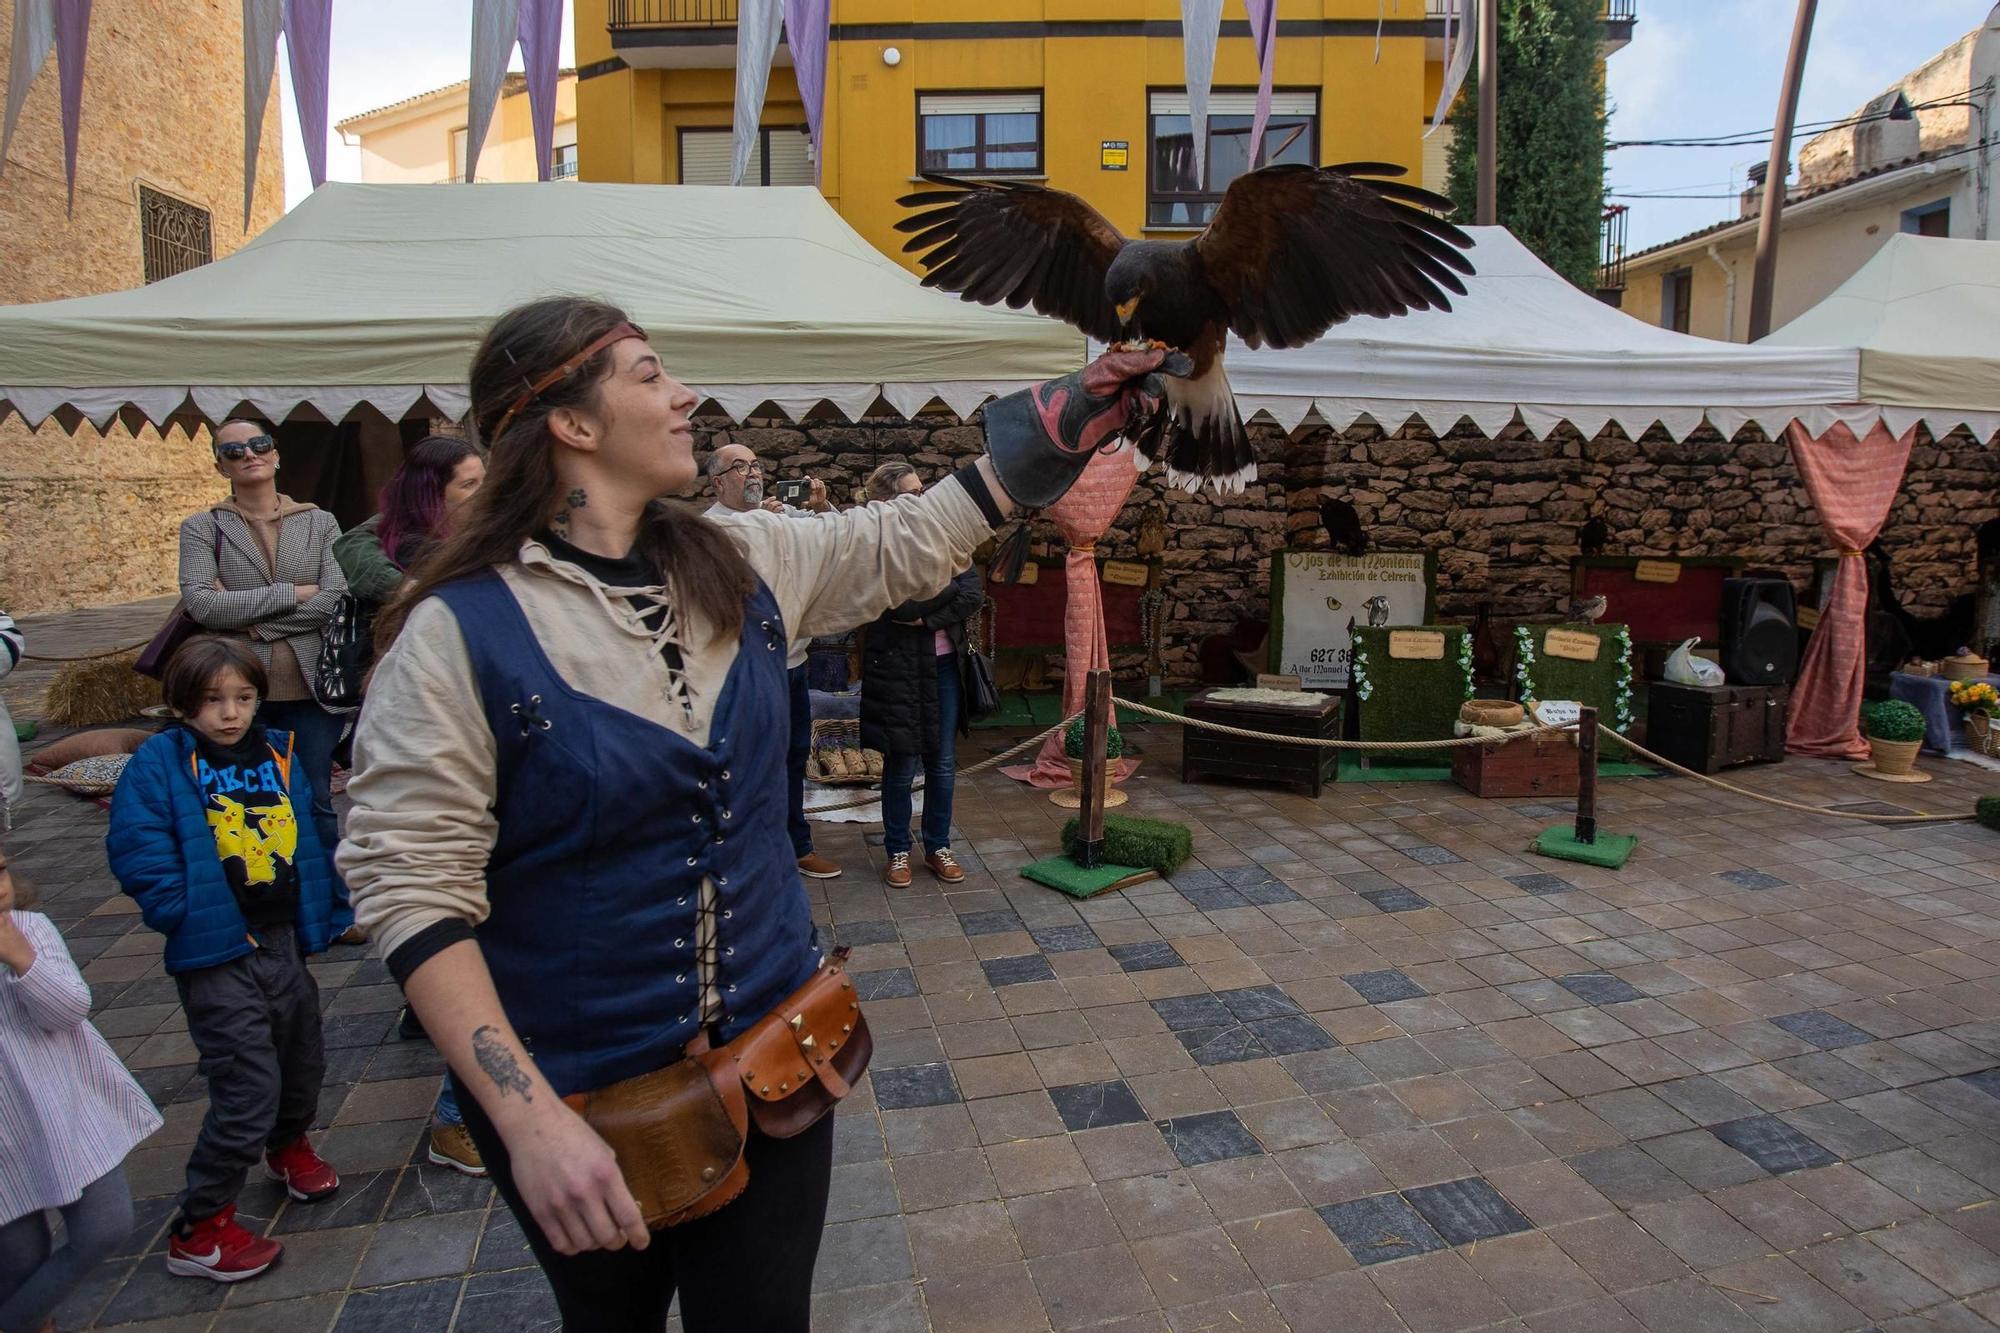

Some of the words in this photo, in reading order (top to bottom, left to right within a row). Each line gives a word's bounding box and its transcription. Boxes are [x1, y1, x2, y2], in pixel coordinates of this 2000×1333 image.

[1328, 554, 1341, 567] de
[1368, 570, 1378, 581] de
[1311, 648, 1336, 663] 627
[1313, 664, 1343, 674] Manuel
